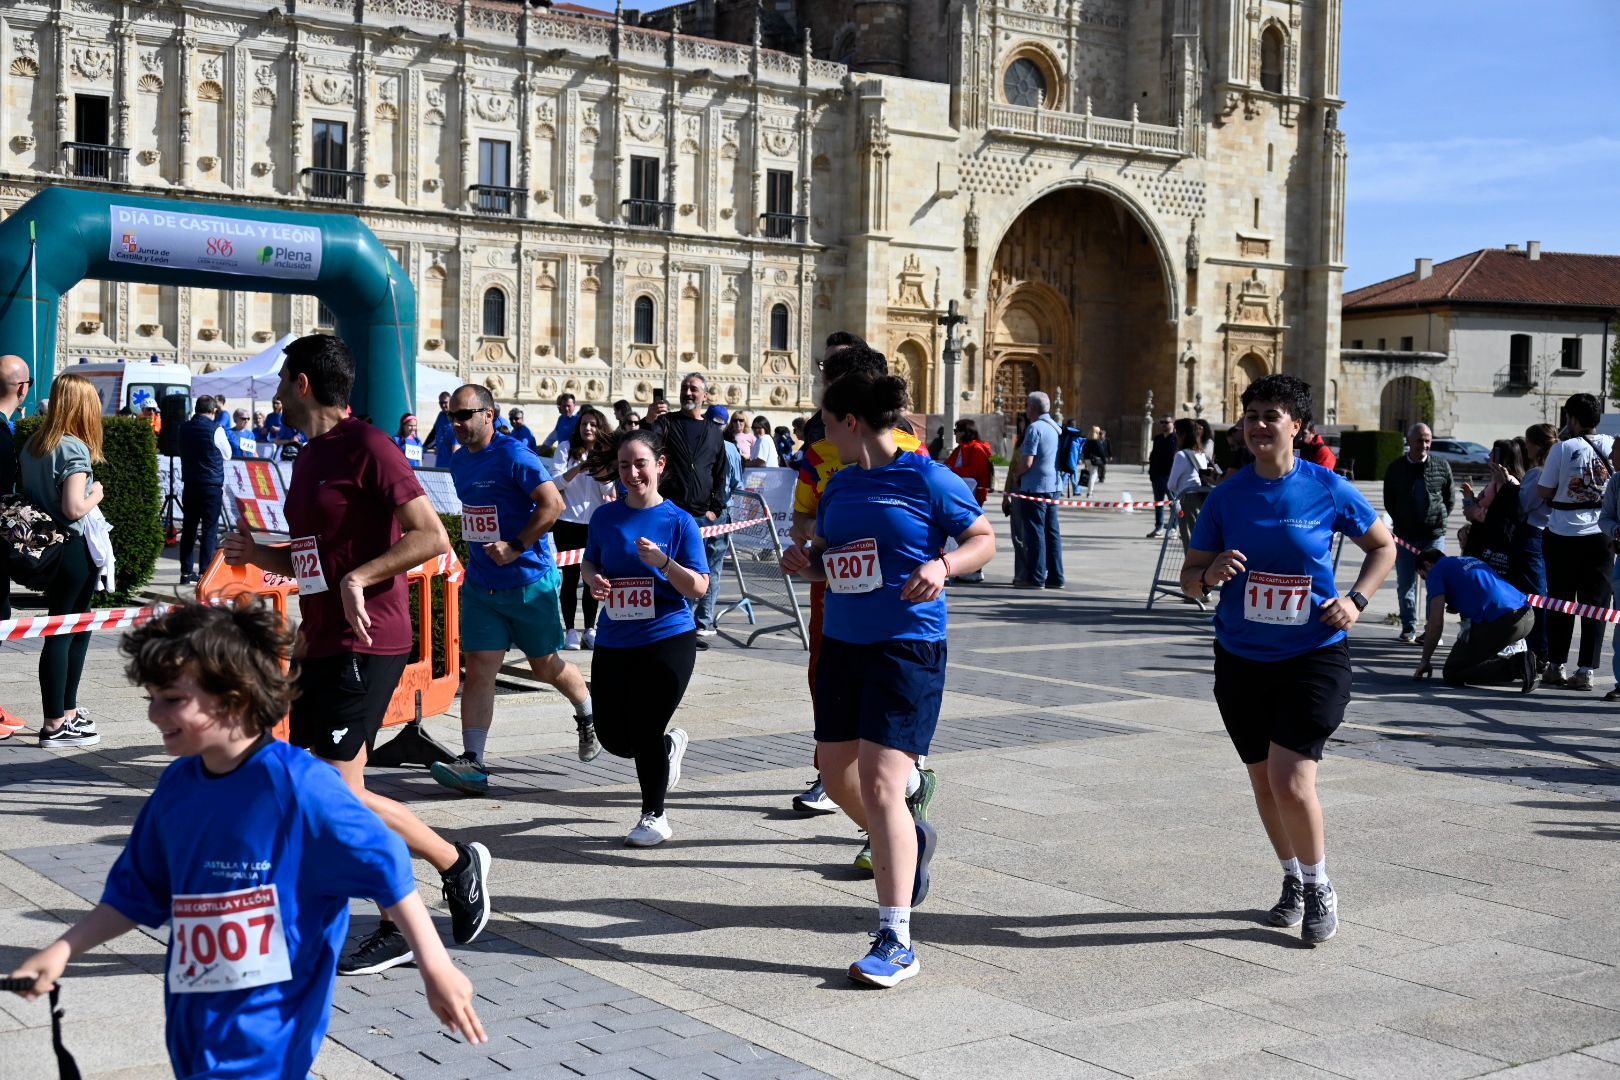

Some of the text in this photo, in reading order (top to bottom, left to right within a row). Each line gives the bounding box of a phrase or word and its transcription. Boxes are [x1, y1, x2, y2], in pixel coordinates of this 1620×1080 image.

[119, 210, 315, 243] DÍA DE CASTILLA Y LEÓN
[117, 251, 142, 260] Castilla
[138, 247, 159, 255] Junta
[275, 247, 312, 261] Plena
[274, 260, 311, 270] inclusión
[463, 515, 497, 532] 1185
[827, 554, 876, 578] 1207
[607, 590, 652, 608] 1148
[1248, 585, 1309, 611] 1177
[242, 862, 249, 870] Y
[193, 900, 232, 912] CASTILLA
[233, 899, 241, 908] Y
[243, 891, 271, 907] LEÓN
[177, 913, 275, 965] 1007
